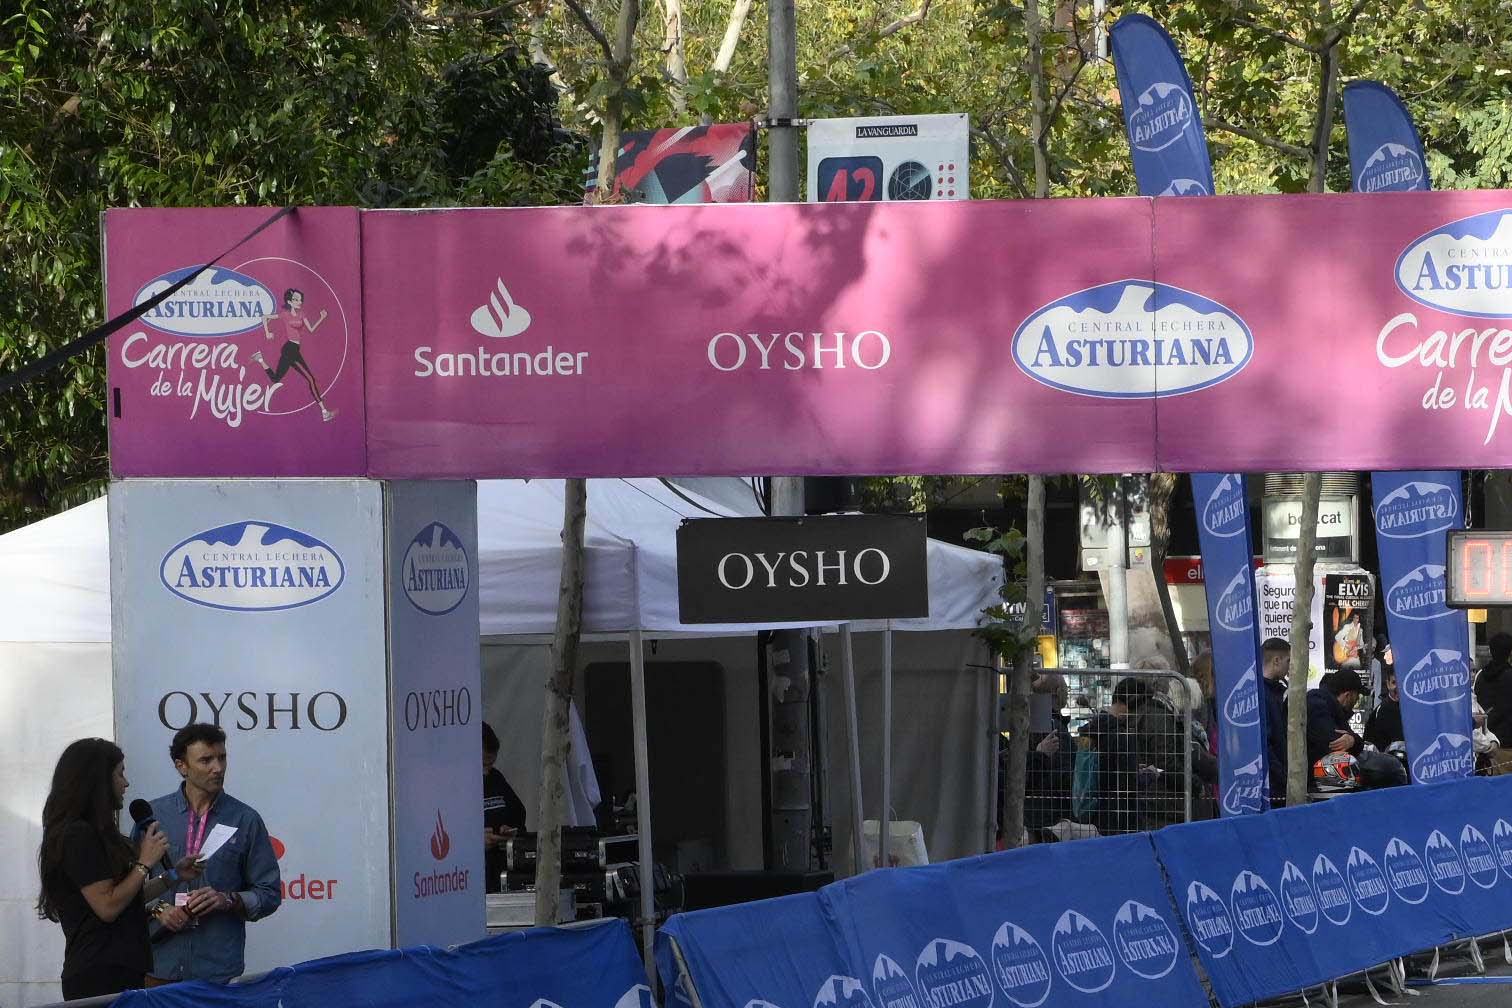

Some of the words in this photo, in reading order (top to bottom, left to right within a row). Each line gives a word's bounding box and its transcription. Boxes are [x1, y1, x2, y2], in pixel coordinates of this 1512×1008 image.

[144, 290, 265, 319] ASTURIANA
[215, 289, 261, 297] LECHERA
[1068, 320, 1145, 333] CENTRAL
[1151, 320, 1227, 332] LECHERA
[120, 331, 239, 370] Carrera
[414, 345, 589, 379] Santander
[706, 331, 891, 372] OYSHO
[1030, 324, 1235, 368] ASTURIANA
[151, 371, 172, 397] de
[177, 370, 192, 397] la
[190, 366, 284, 428] Mujer
[1422, 371, 1457, 410] de
[1464, 368, 1489, 410] la
[175, 554, 331, 588] ASTURIANA
[203, 553, 261, 561] CENTRAL
[265, 552, 324, 561] LECHERA
[717, 547, 890, 590] OYSHO
[407, 558, 466, 593] ASTURIANA
[1338, 583, 1369, 596] ELVIS
[1263, 601, 1280, 613] que
[1338, 599, 1351, 607] BILL
[158, 691, 348, 732] OYSHO
[404, 686, 472, 732] OYSHO
[413, 867, 470, 899] Santander
[996, 957, 1049, 989] ASTURIANA
[1058, 943, 1113, 976] ASTURIANA
